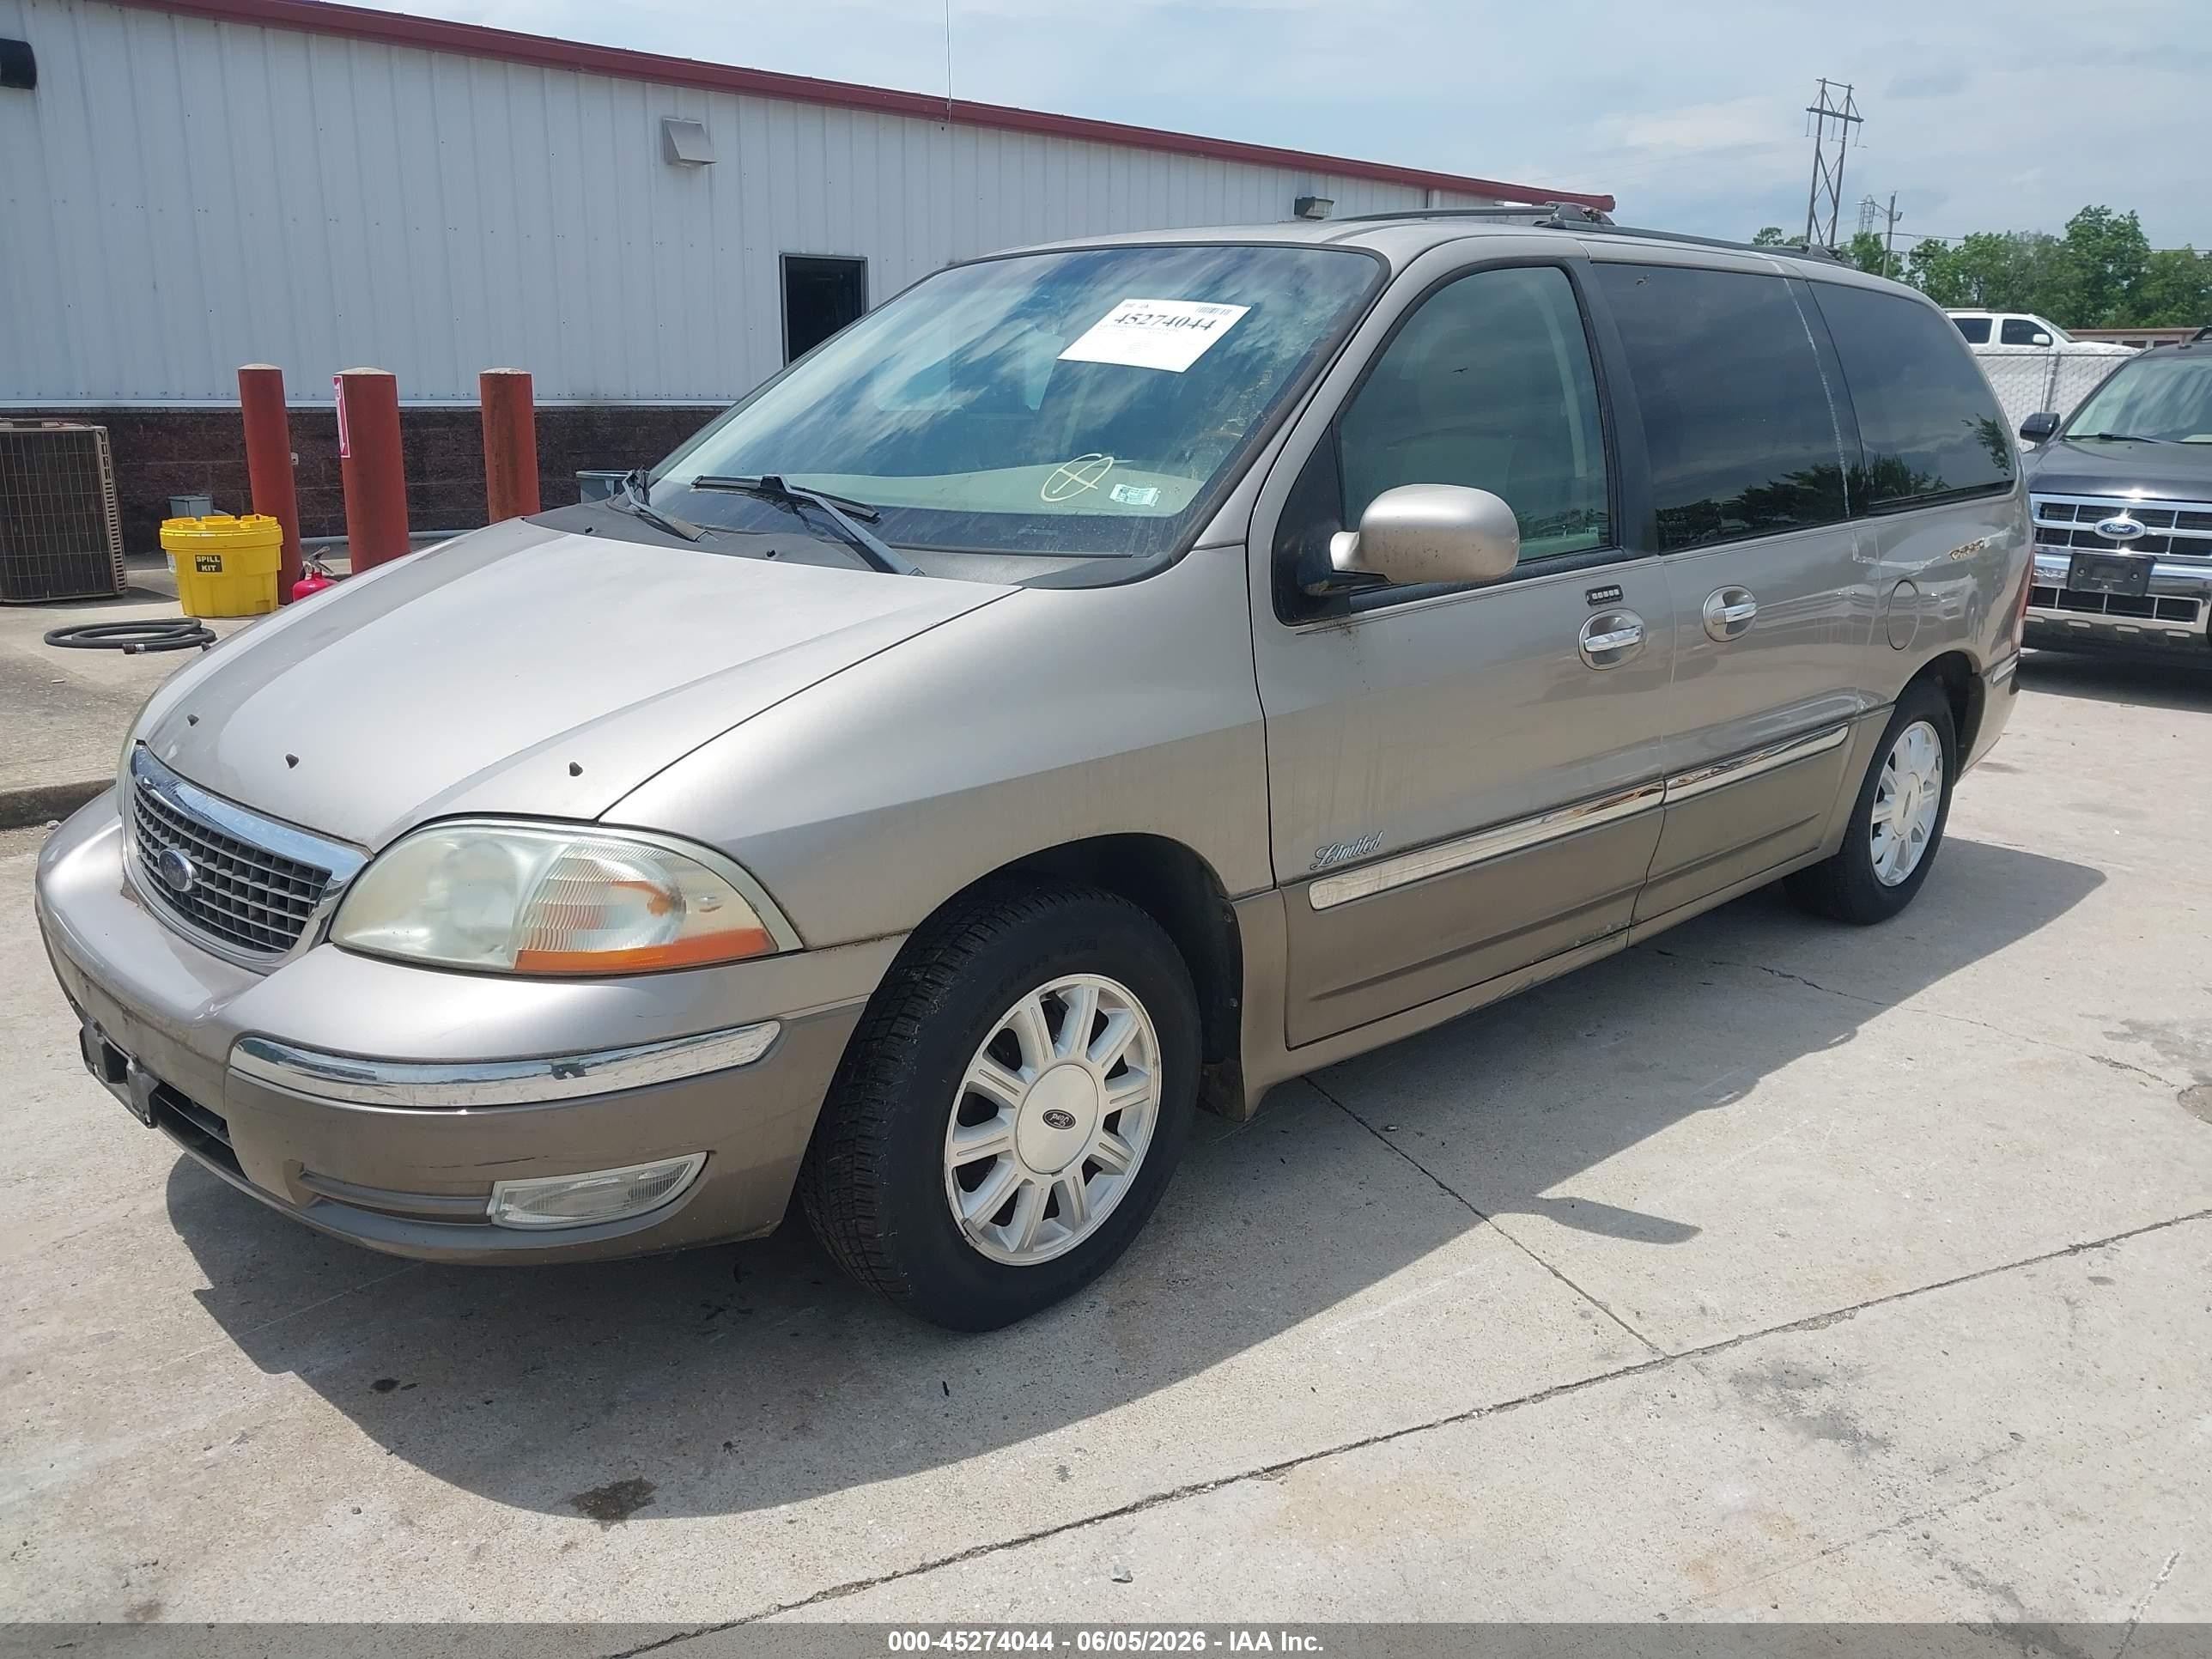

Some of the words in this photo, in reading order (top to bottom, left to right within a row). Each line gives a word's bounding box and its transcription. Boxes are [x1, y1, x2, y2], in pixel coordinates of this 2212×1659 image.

[1114, 313, 1217, 331] 45274044
[97, 431, 112, 480] YORK
[1310, 830, 1383, 870] Limited
[1049, 1113, 1070, 1127] Ford
